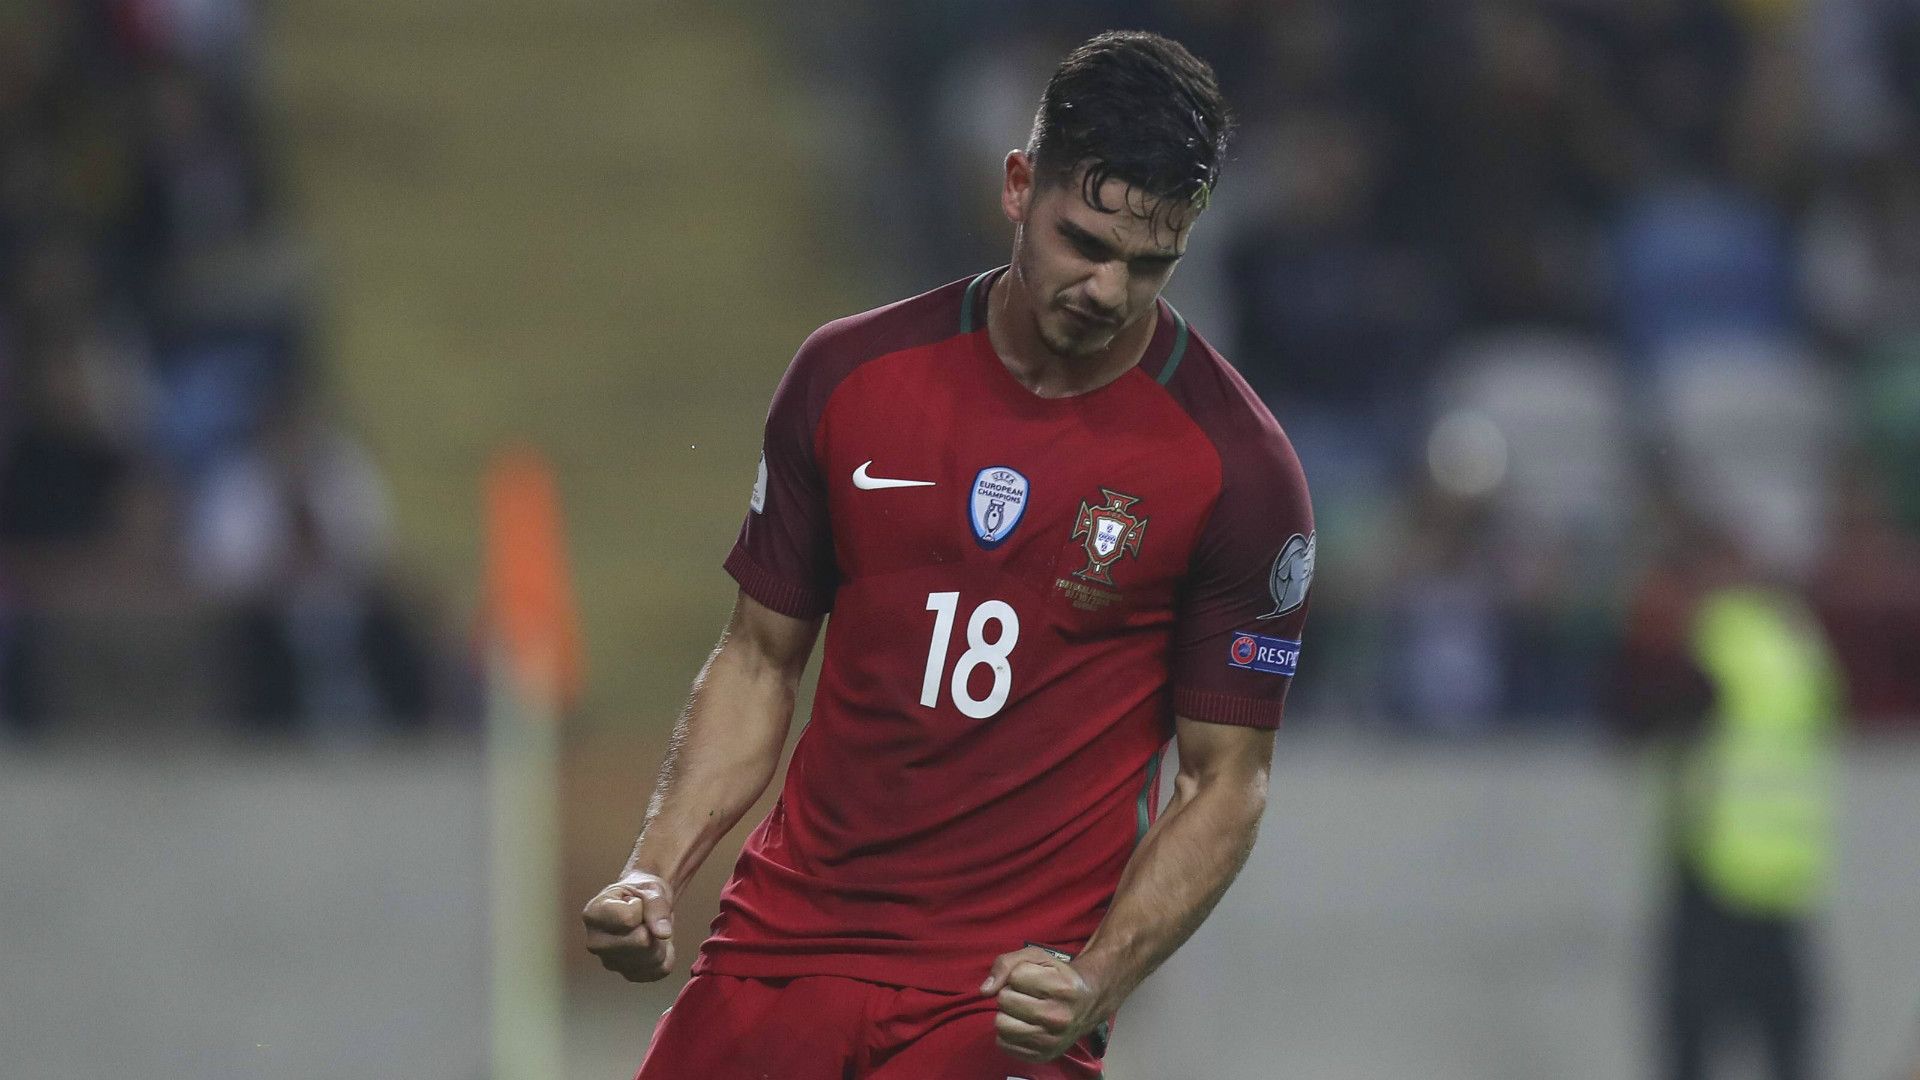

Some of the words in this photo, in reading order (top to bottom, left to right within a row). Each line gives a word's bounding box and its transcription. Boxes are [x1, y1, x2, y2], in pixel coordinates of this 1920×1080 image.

[992, 472, 1015, 484] UEFA
[977, 488, 1021, 504] CHAMPIONS
[979, 480, 1024, 497] EUROPEAN
[920, 591, 1019, 719] 18
